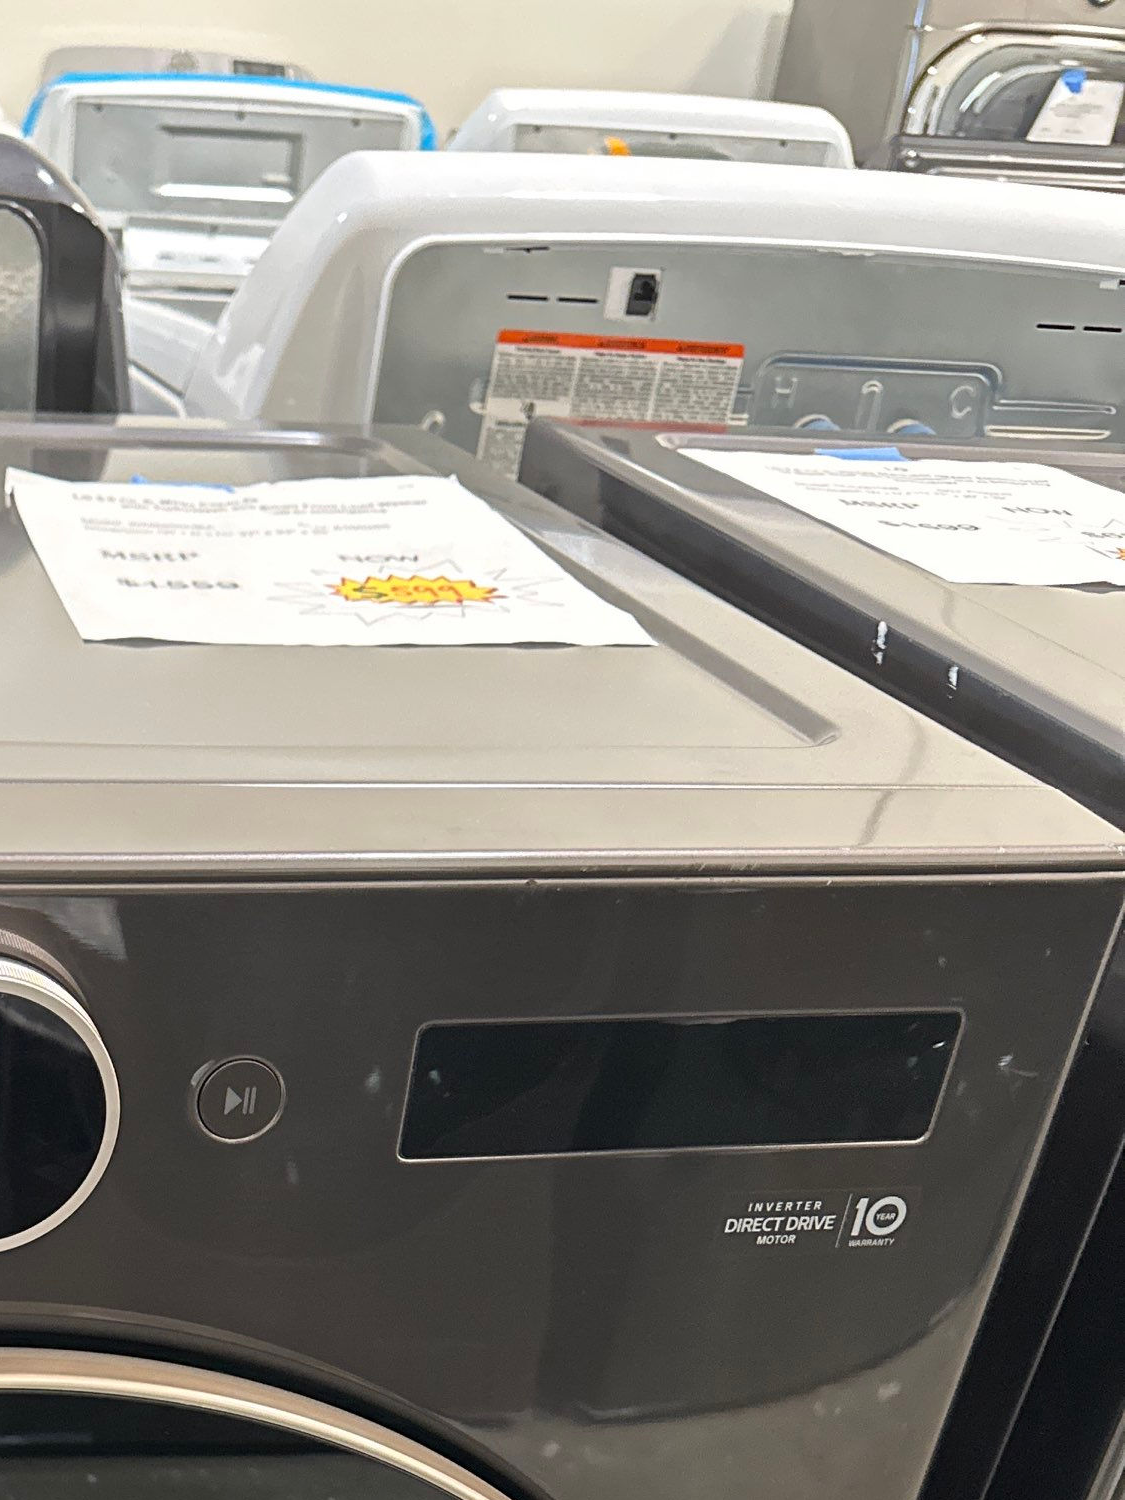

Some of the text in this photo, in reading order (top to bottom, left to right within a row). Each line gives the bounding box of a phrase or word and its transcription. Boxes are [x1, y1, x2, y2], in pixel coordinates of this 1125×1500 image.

[948, 385, 974, 419] C
[747, 1200, 823, 1213] INVERTER
[850, 1195, 908, 1237] 10
[876, 1212, 897, 1221] YEAR
[724, 1214, 837, 1234] DIRECT DRIVE
[756, 1234, 797, 1245] MOTOR
[848, 1237, 895, 1247] WARRANTY
